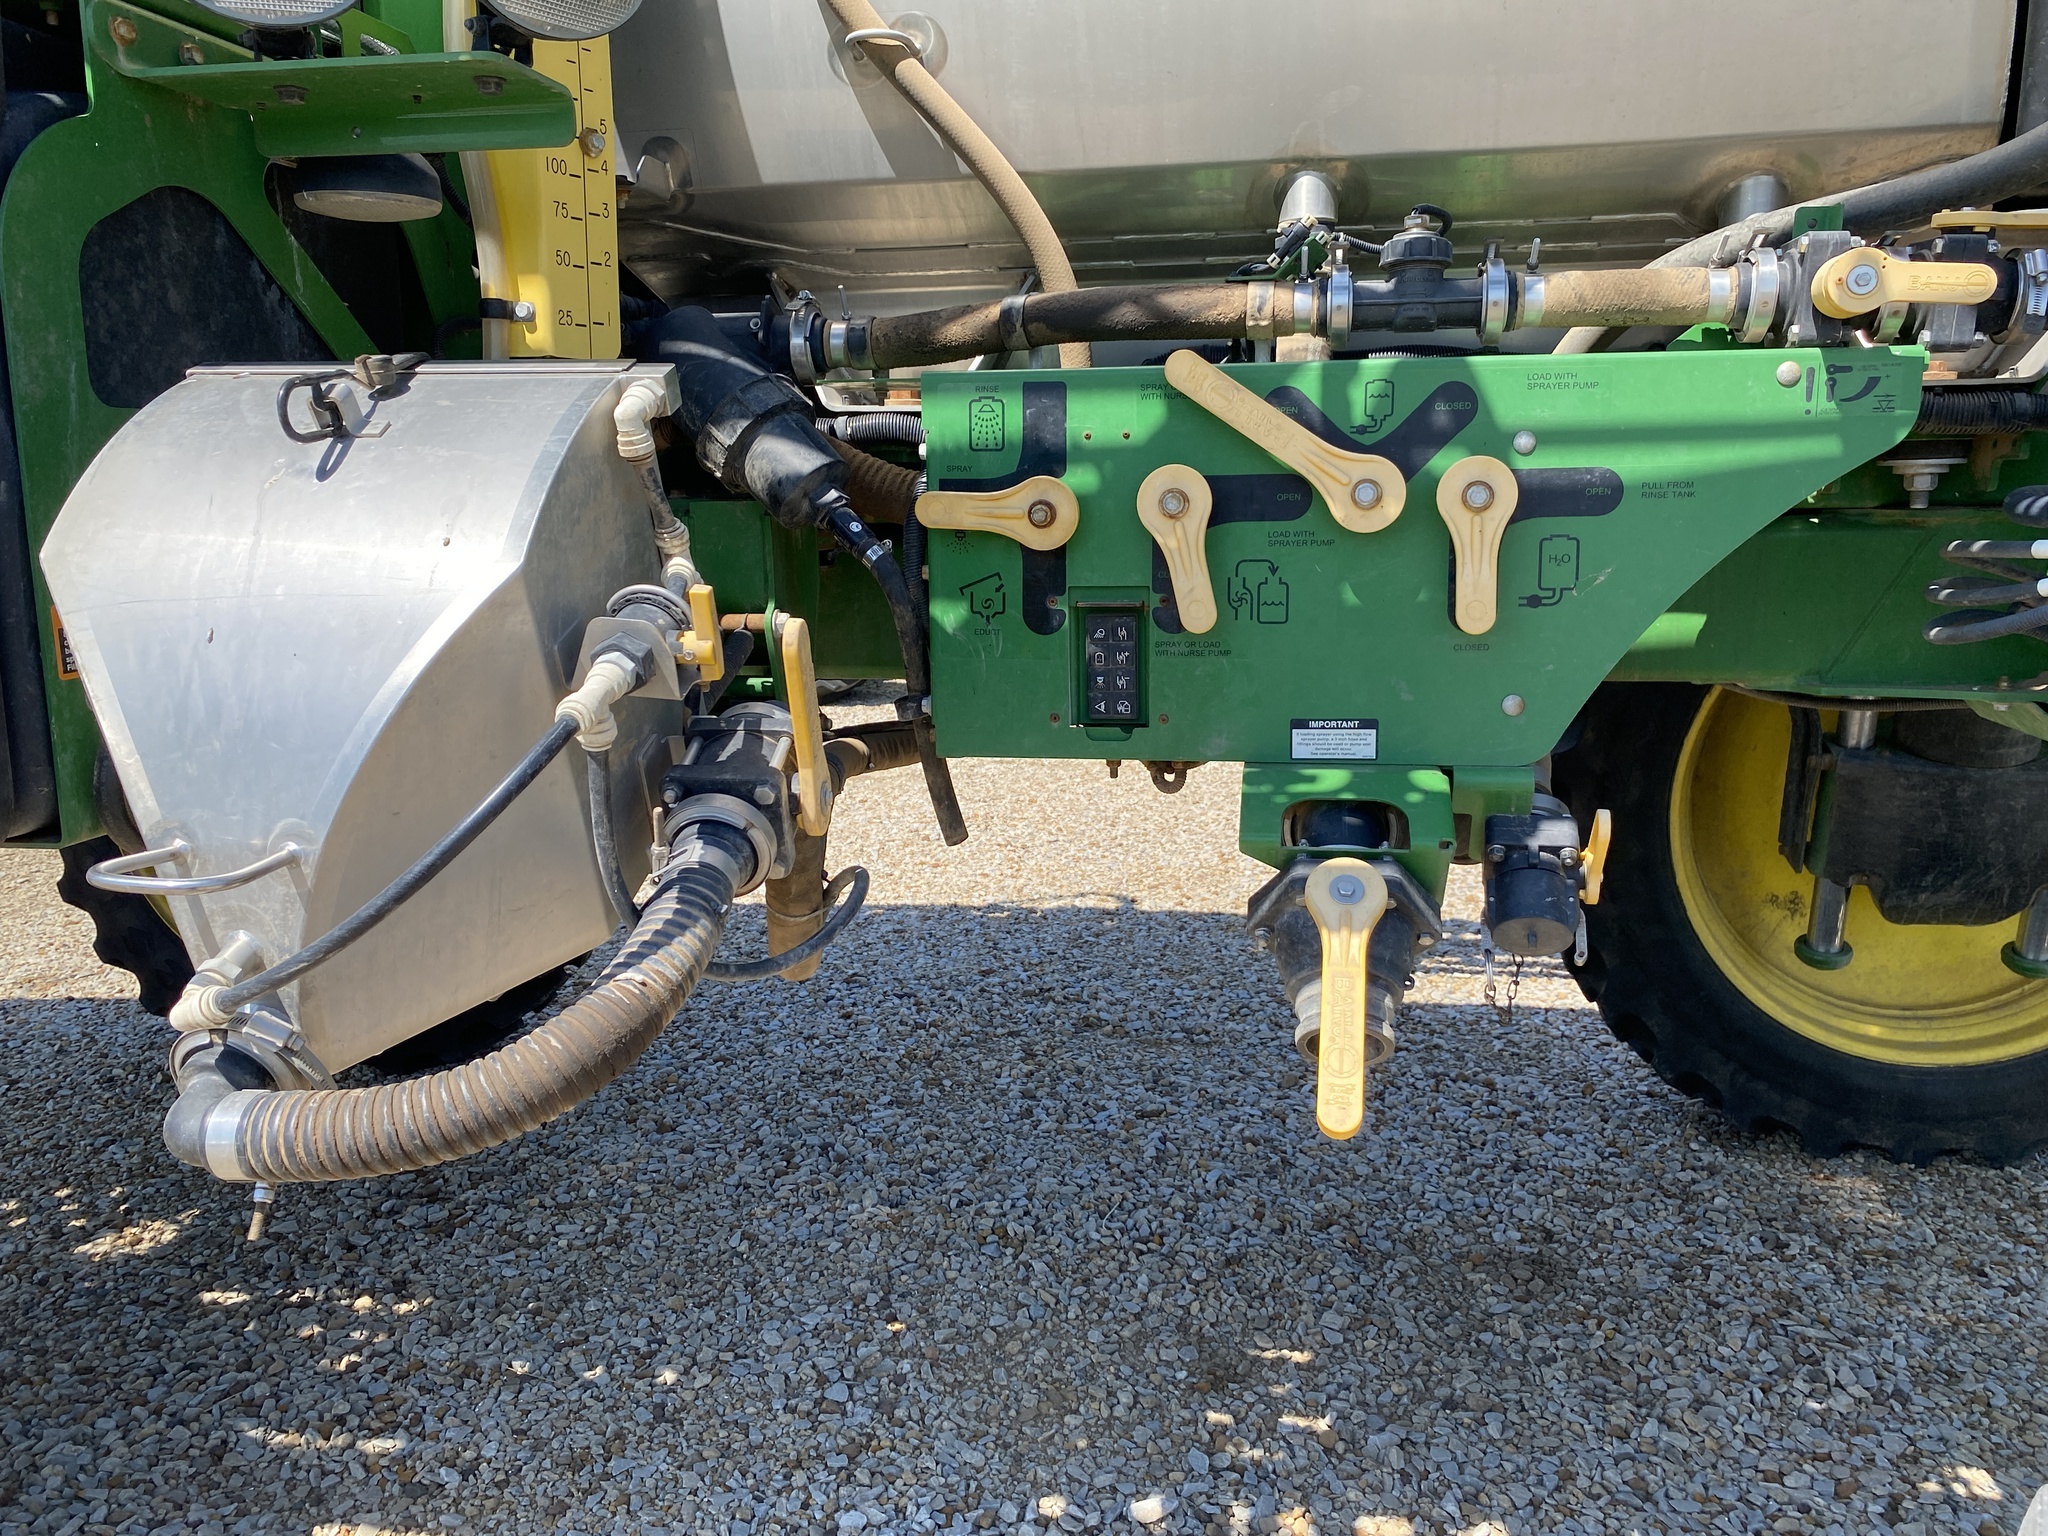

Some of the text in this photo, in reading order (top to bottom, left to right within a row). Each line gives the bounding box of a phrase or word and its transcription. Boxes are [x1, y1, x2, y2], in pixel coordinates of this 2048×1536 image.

[599, 119, 607, 135] 5
[546, 156, 567, 175] 100
[601, 160, 609, 176] 4
[553, 201, 569, 219] 75
[602, 203, 610, 218] 3
[556, 250, 571, 267] 50
[604, 251, 611, 267] 2
[558, 309, 573, 326] 25
[1527, 372, 1578, 381] LOAD WITH
[975, 385, 1000, 393] RINSE
[1527, 381, 1599, 390] SPRAYER PUMP
[1434, 402, 1472, 410] CLOSED
[1641, 481, 1694, 490] PULL FROM
[1585, 488, 1612, 496] OPEN
[1641, 490, 1697, 499] RINSE TANK
[1277, 493, 1301, 501] OPEN
[1267, 530, 1315, 538] LOAD WITH
[1267, 539, 1335, 547] SPRAYER PUMP
[1453, 643, 1490, 651] CLOSED
[1154, 649, 1232, 657] WITH NURSE PUMP
[1308, 720, 1360, 728] IMPORTANT
